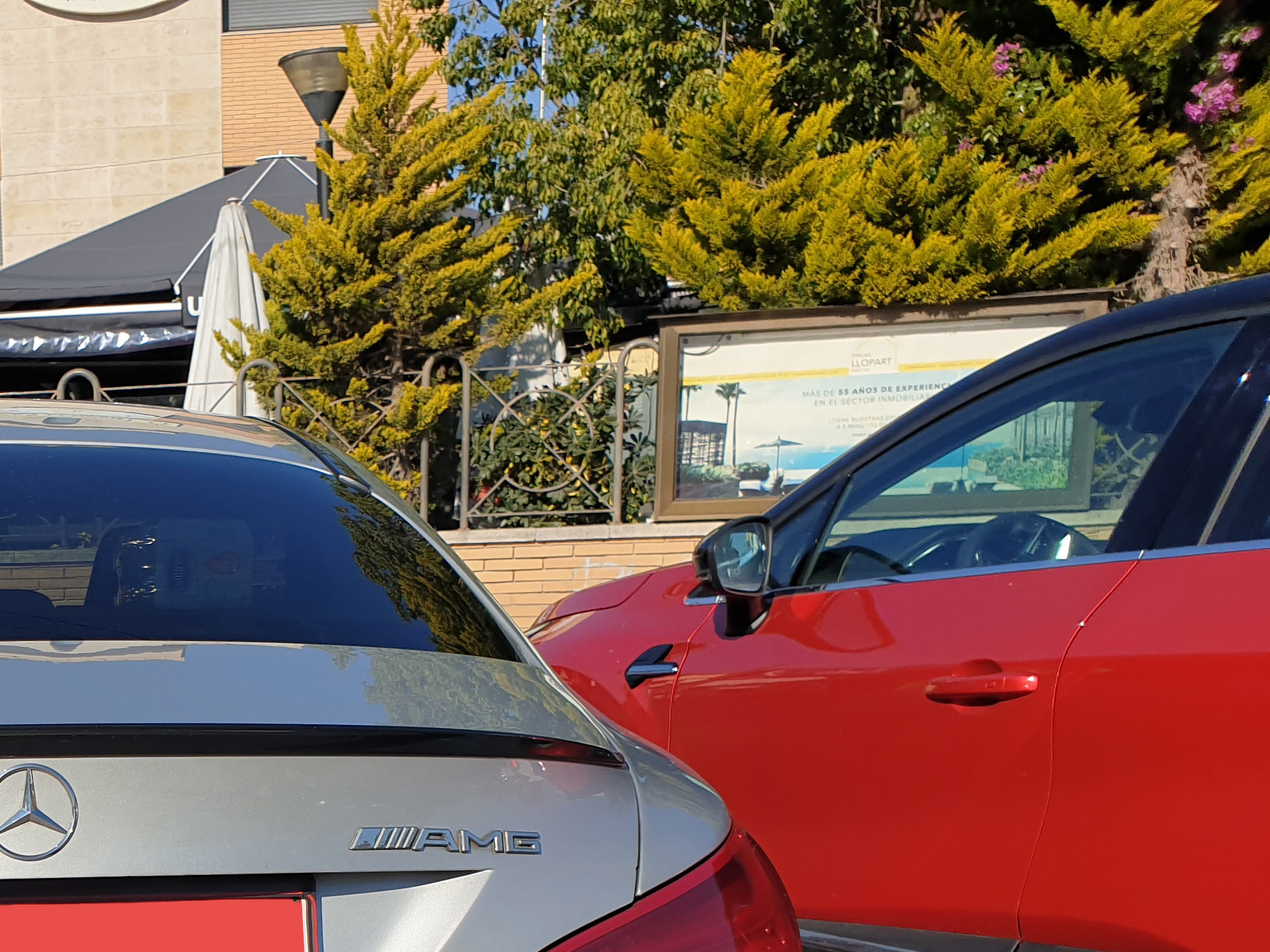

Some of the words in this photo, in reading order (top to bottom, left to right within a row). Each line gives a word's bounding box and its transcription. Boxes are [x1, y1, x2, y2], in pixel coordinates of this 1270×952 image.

[851, 357, 892, 368] LLOPART
[823, 389, 835, 398] DE
[851, 386, 878, 395] AÑOS
[814, 399, 826, 407] EN
[828, 398, 838, 406] EL
[841, 397, 876, 406] SECTOR
[412, 827, 542, 855] AMG
